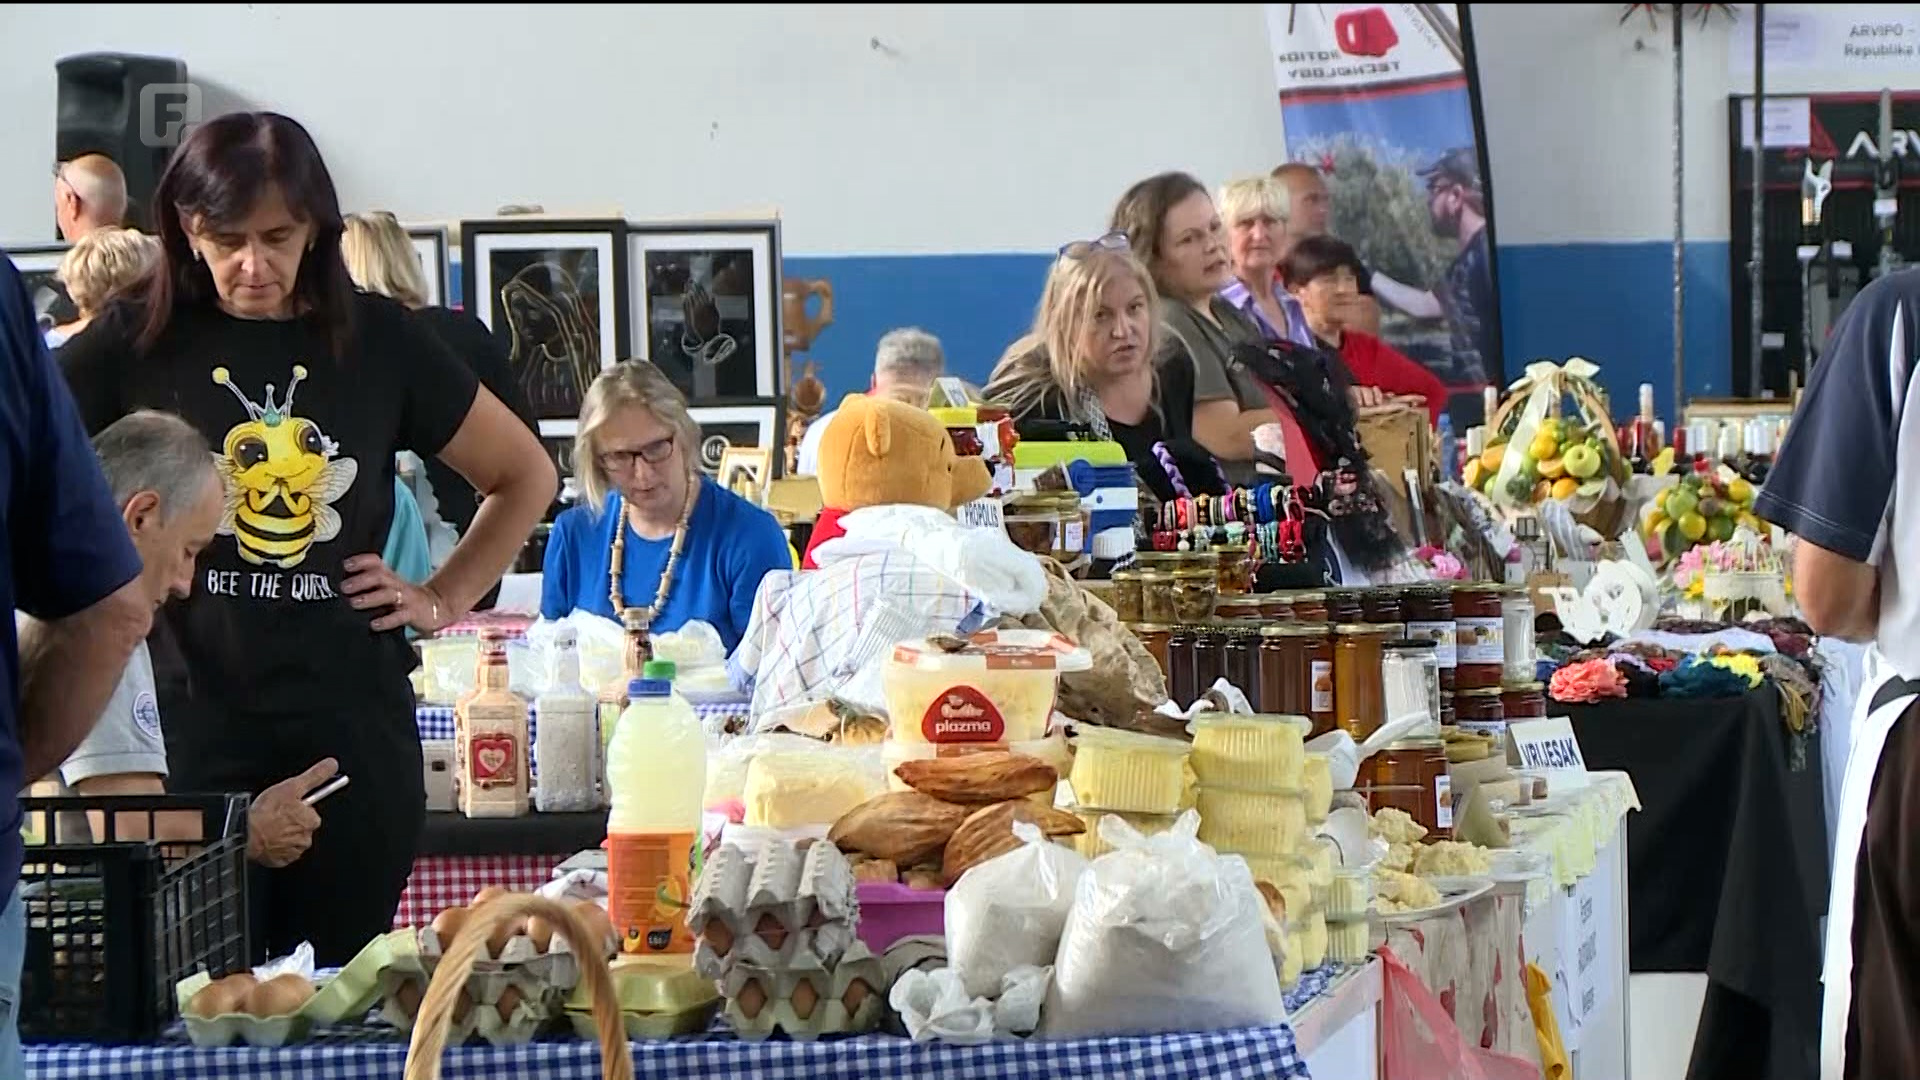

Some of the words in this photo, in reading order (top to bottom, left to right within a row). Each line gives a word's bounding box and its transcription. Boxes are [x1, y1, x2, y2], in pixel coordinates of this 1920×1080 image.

[1849, 23, 1904, 38] ARVIPO
[964, 502, 999, 528] PROPOLIS
[207, 569, 241, 597] BEE
[249, 573, 283, 599] THE
[935, 719, 992, 736] plazma
[1519, 737, 1581, 768] VRIJESAK
